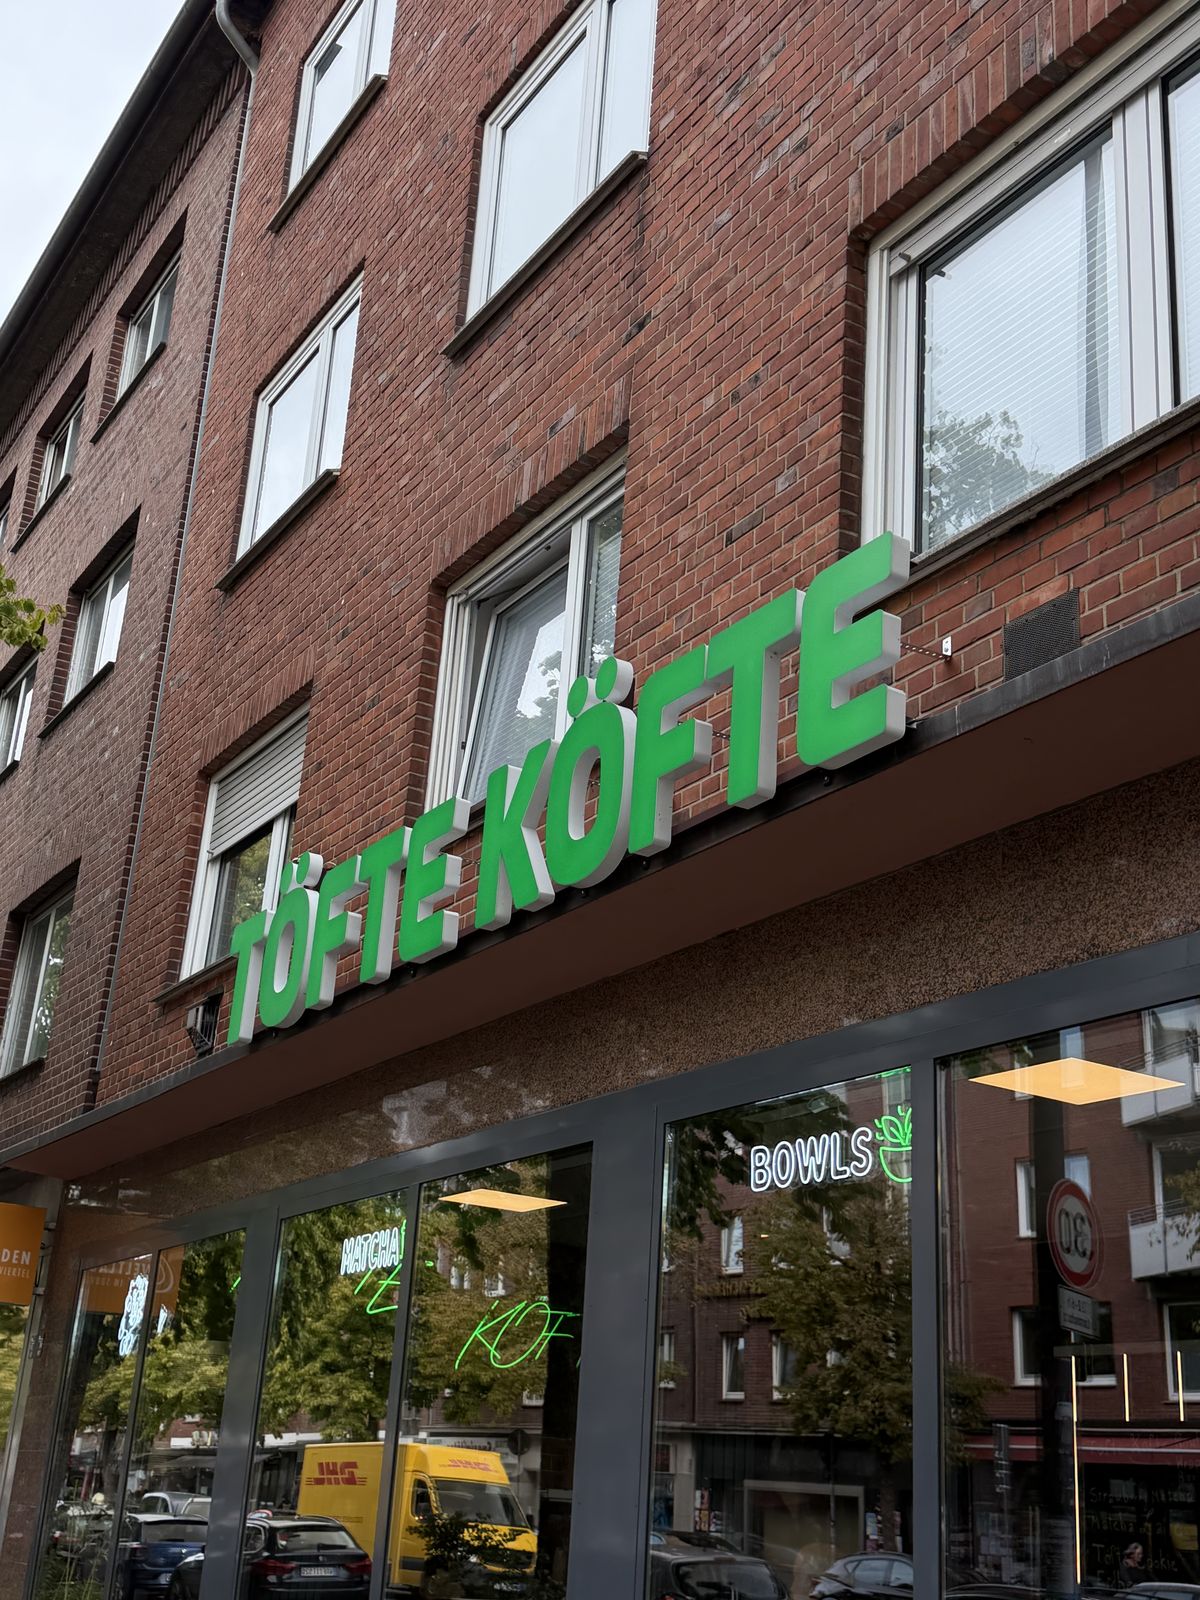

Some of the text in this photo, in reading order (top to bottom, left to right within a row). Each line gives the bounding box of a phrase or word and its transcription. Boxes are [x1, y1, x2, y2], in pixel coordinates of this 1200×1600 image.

[227, 530, 909, 1046] TÖFTE KÖFTE
[750, 1126, 873, 1192] BOWLS
[340, 1227, 399, 1276] MATCHA
